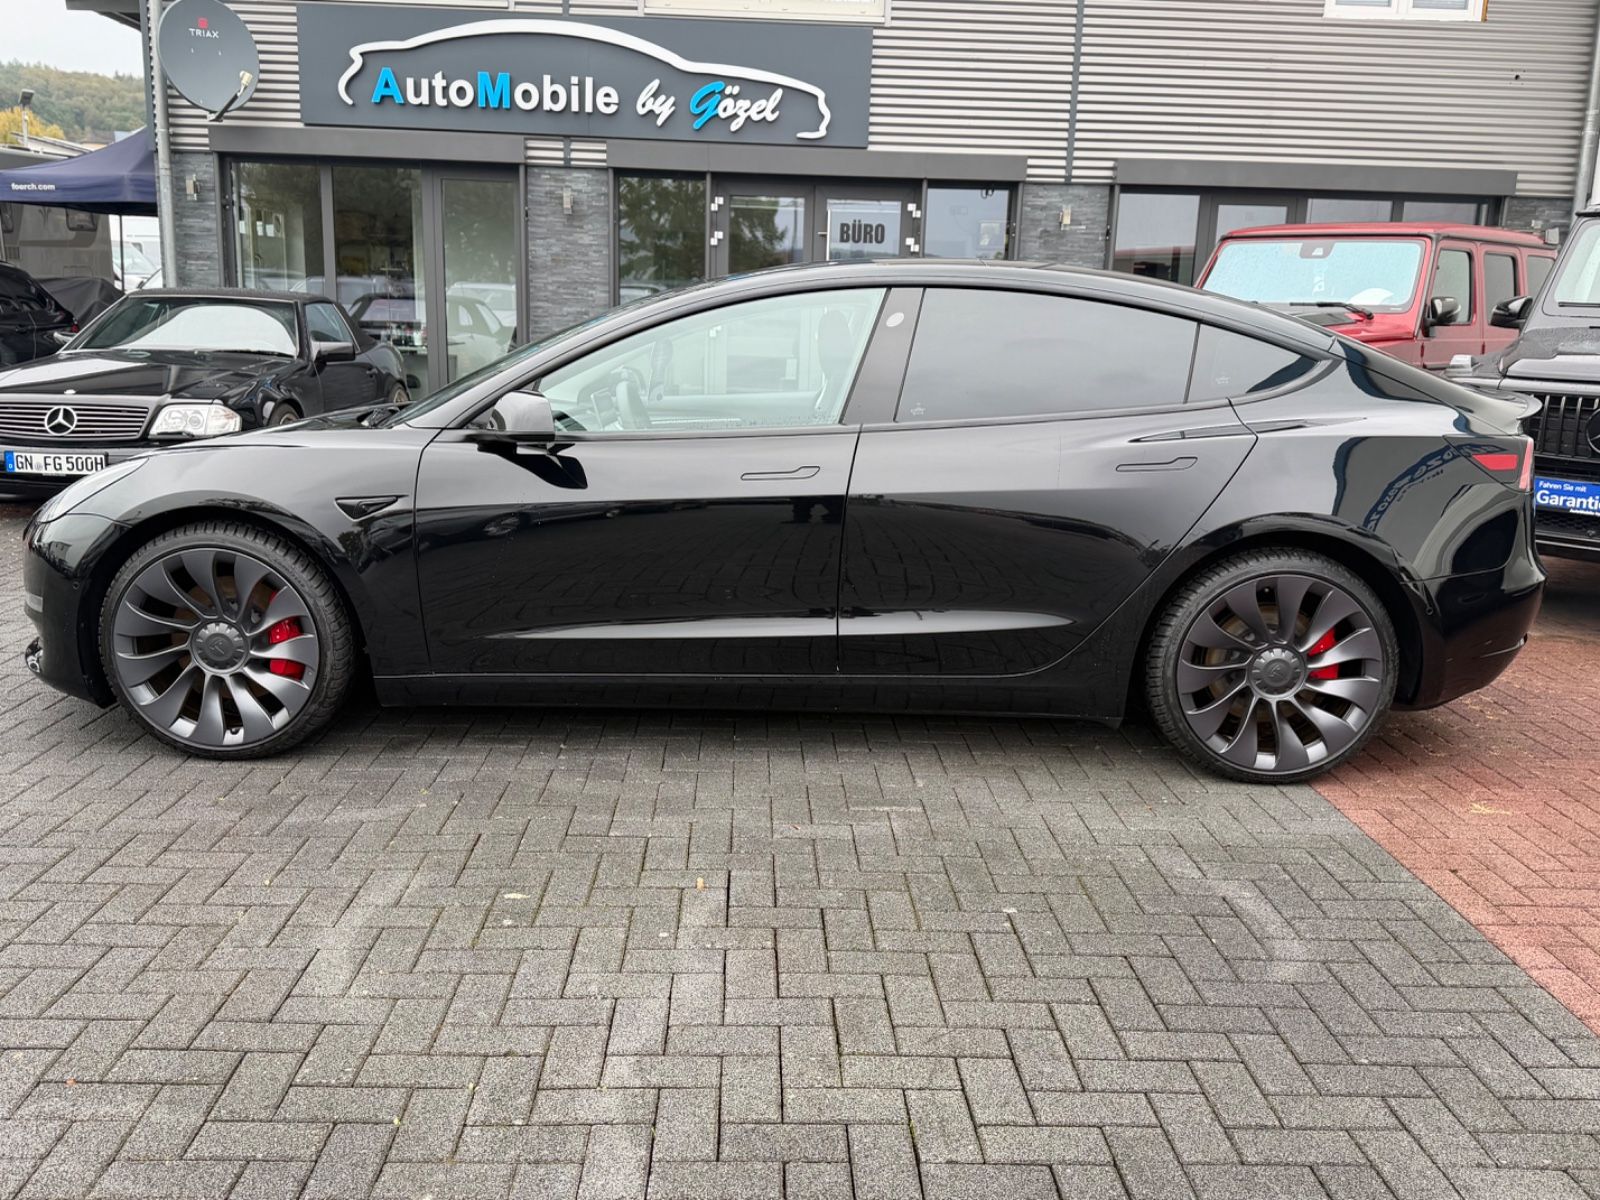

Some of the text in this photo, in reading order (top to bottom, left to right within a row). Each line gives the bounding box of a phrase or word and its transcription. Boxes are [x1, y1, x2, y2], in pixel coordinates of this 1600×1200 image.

[188, 27, 219, 39] TRIAX
[371, 66, 784, 132] AutoMobile by Gözel
[839, 219, 886, 244] BÜRO
[15, 454, 104, 472] GN FG 500H
[1539, 481, 1562, 490] Fahren
[1536, 490, 1600, 510] Garanti
